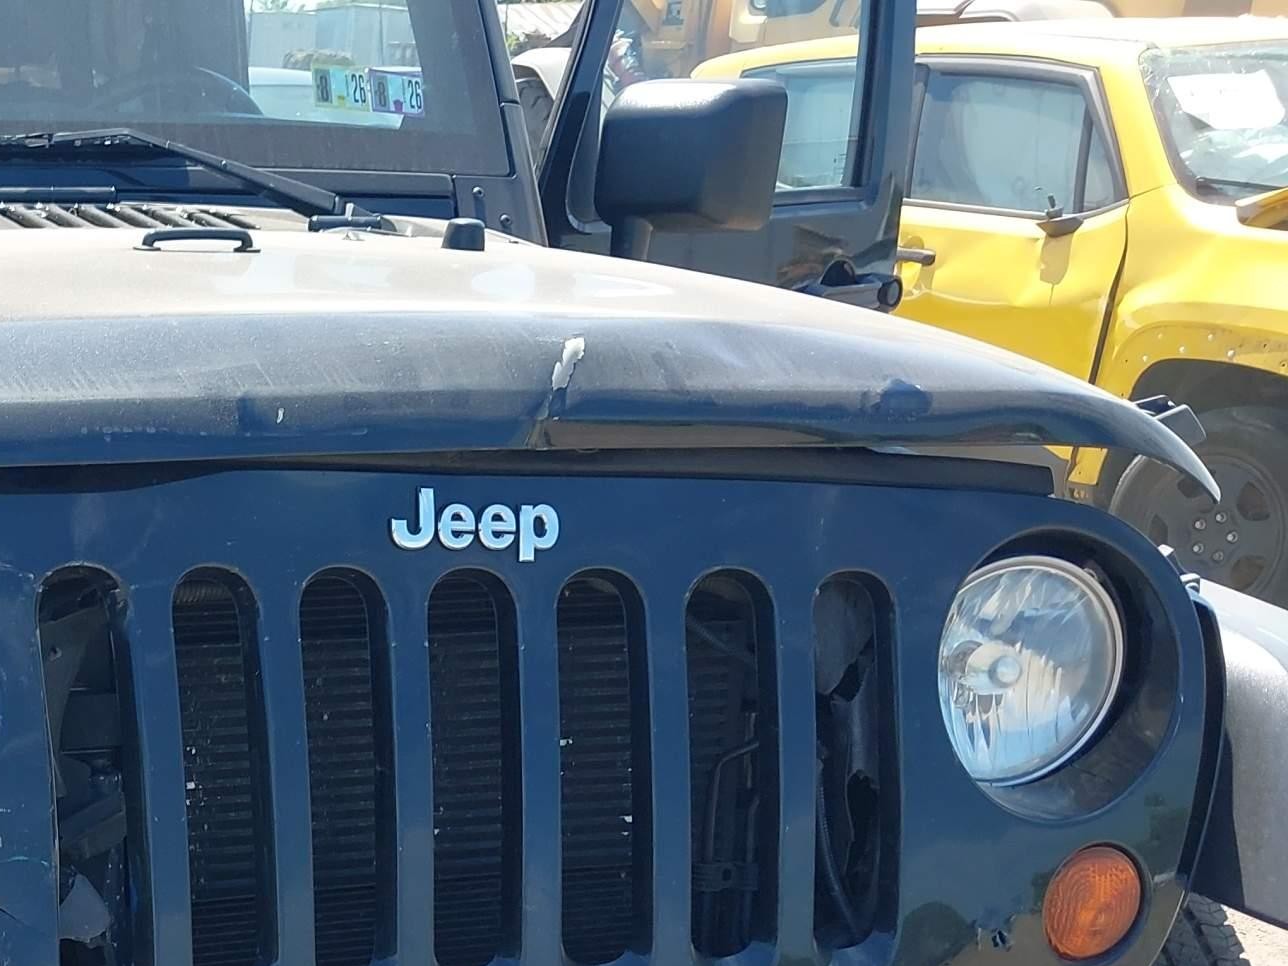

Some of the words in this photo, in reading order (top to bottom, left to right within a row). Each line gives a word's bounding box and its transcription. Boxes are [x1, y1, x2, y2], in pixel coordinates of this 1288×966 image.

[319, 75, 329, 102] 8
[351, 73, 367, 104] 26
[377, 81, 387, 108] 8
[408, 79, 423, 110] 26
[390, 487, 560, 563] Jeep
